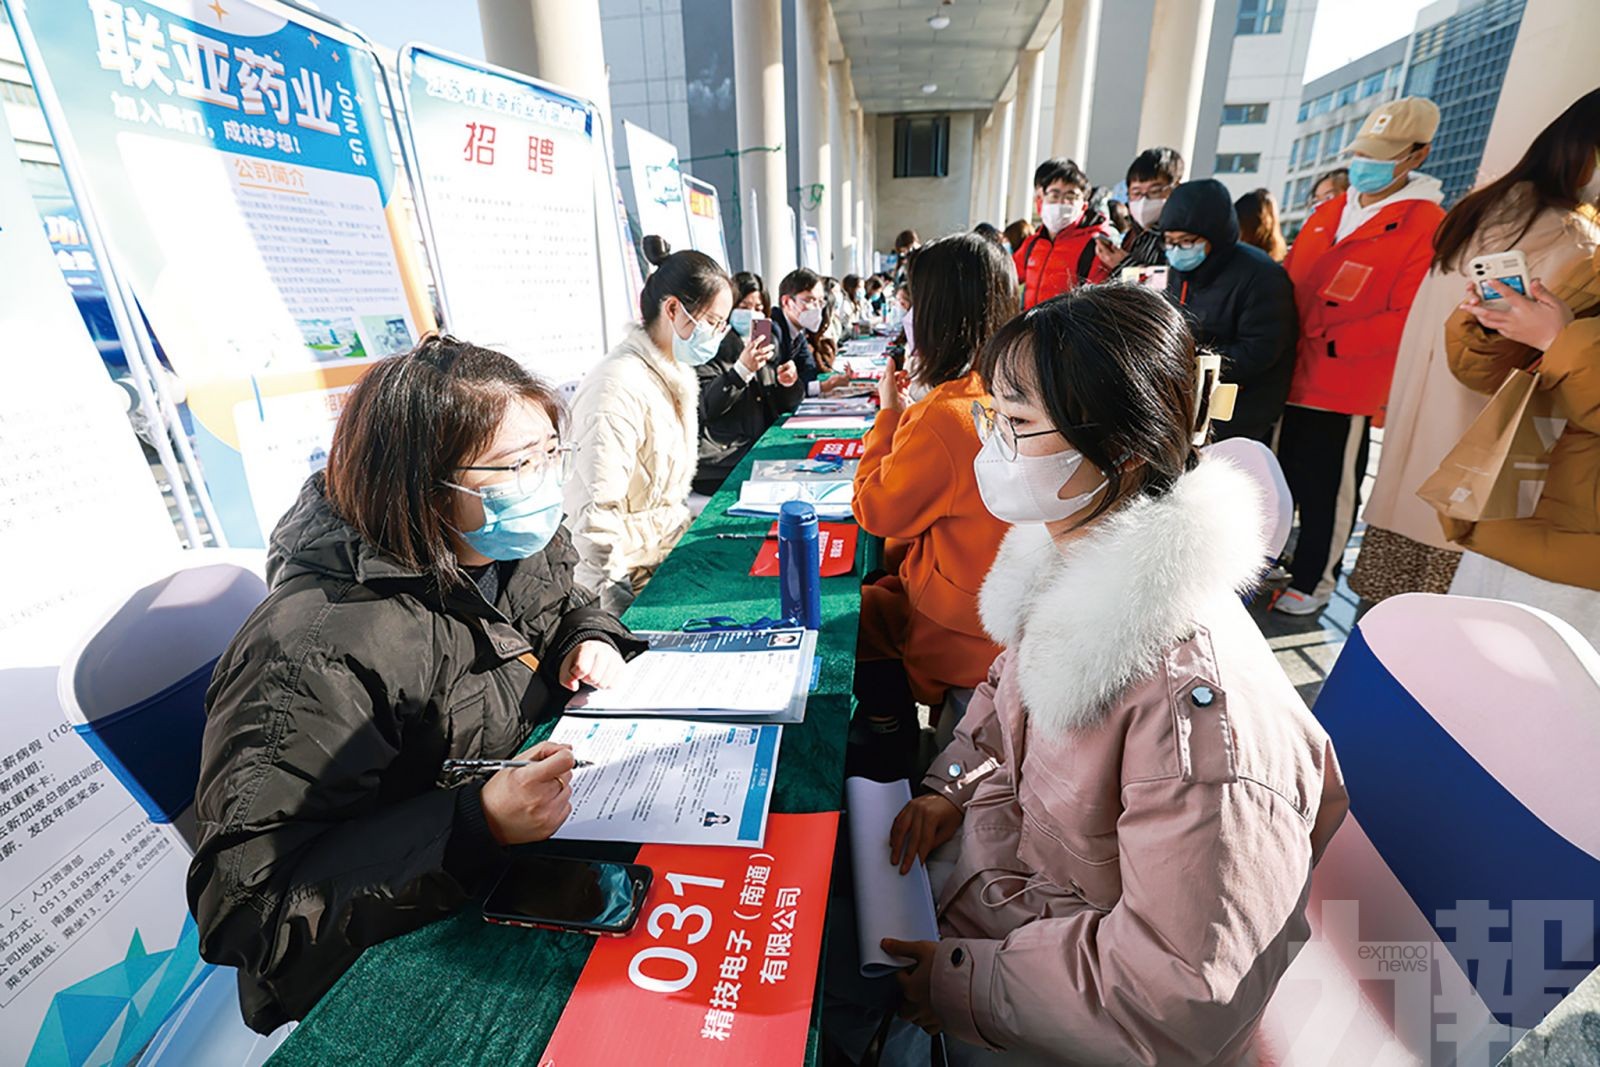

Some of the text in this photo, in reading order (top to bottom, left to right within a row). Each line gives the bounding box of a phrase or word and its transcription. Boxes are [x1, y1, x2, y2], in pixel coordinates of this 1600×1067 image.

[88, 0, 341, 136] 联亚药业
[336, 81, 367, 166] JOIN US
[234, 159, 304, 188] 公司简介
[628, 872, 726, 993] 031
[759, 887, 801, 985] 有限公司
